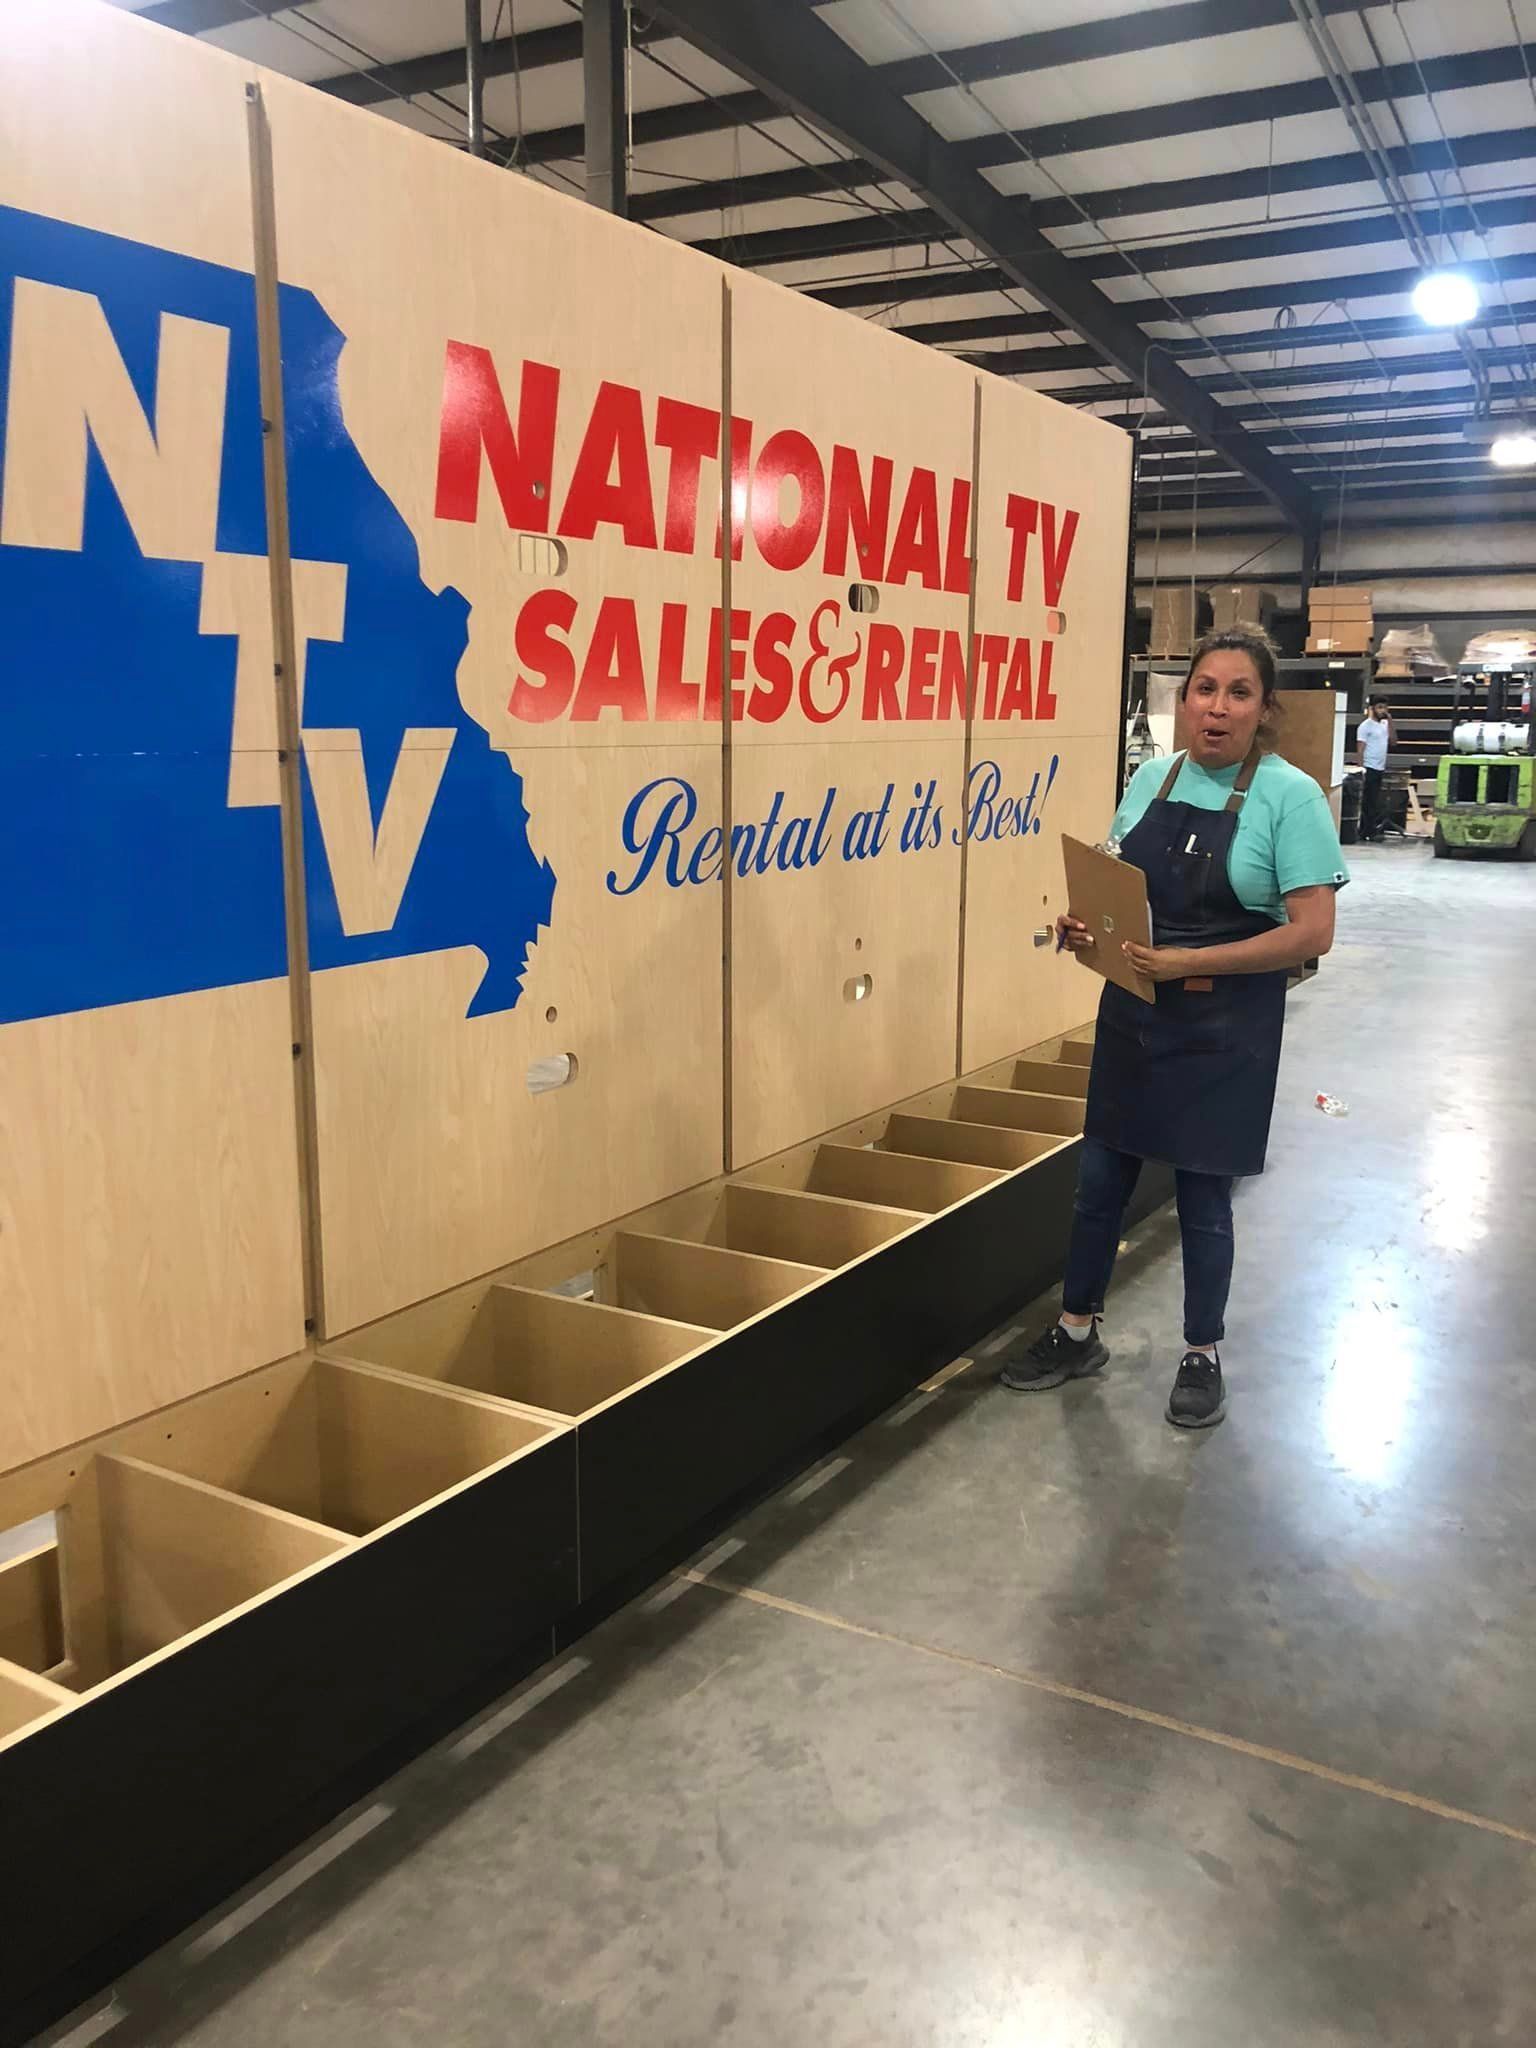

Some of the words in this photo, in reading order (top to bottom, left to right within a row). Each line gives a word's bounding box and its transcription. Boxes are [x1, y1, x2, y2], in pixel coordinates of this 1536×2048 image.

[434, 339, 977, 595] NATIONAL
[1005, 493, 1080, 608] TV
[507, 589, 797, 723] SALES
[861, 622, 1057, 721] RENTAL
[606, 777, 837, 896] Rental
[842, 783, 896, 862] at
[900, 780, 944, 853] its
[951, 754, 1060, 847] Best!
